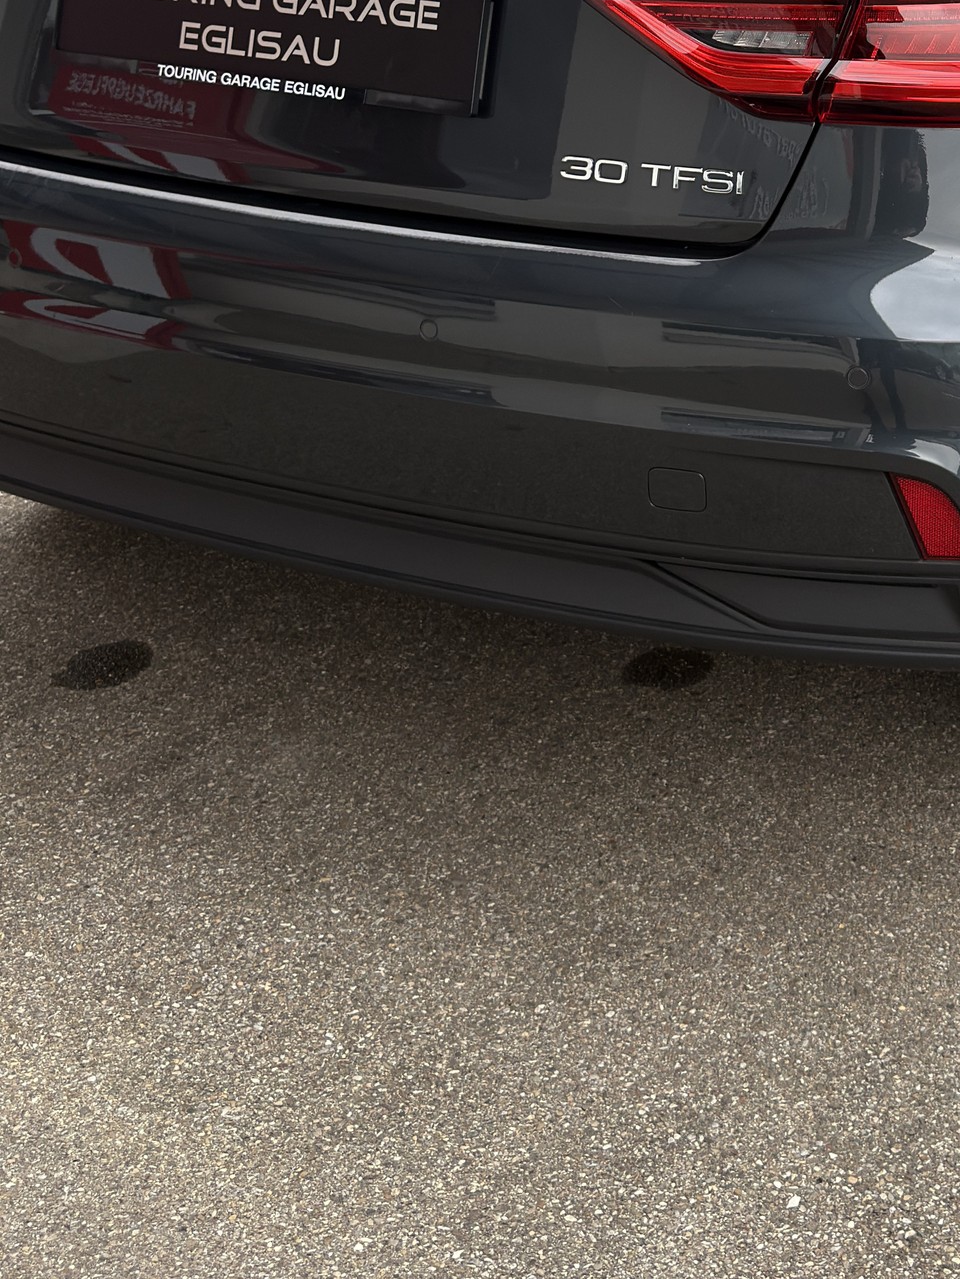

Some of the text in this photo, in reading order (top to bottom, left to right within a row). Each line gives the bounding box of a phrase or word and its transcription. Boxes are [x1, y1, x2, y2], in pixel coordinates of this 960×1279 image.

[178, 21, 341, 67] EGLISAU
[157, 63, 217, 84] TOURING
[220, 72, 281, 93] GARAGE
[284, 80, 346, 101] EGLISAU
[560, 155, 745, 195] 30 TFSI
